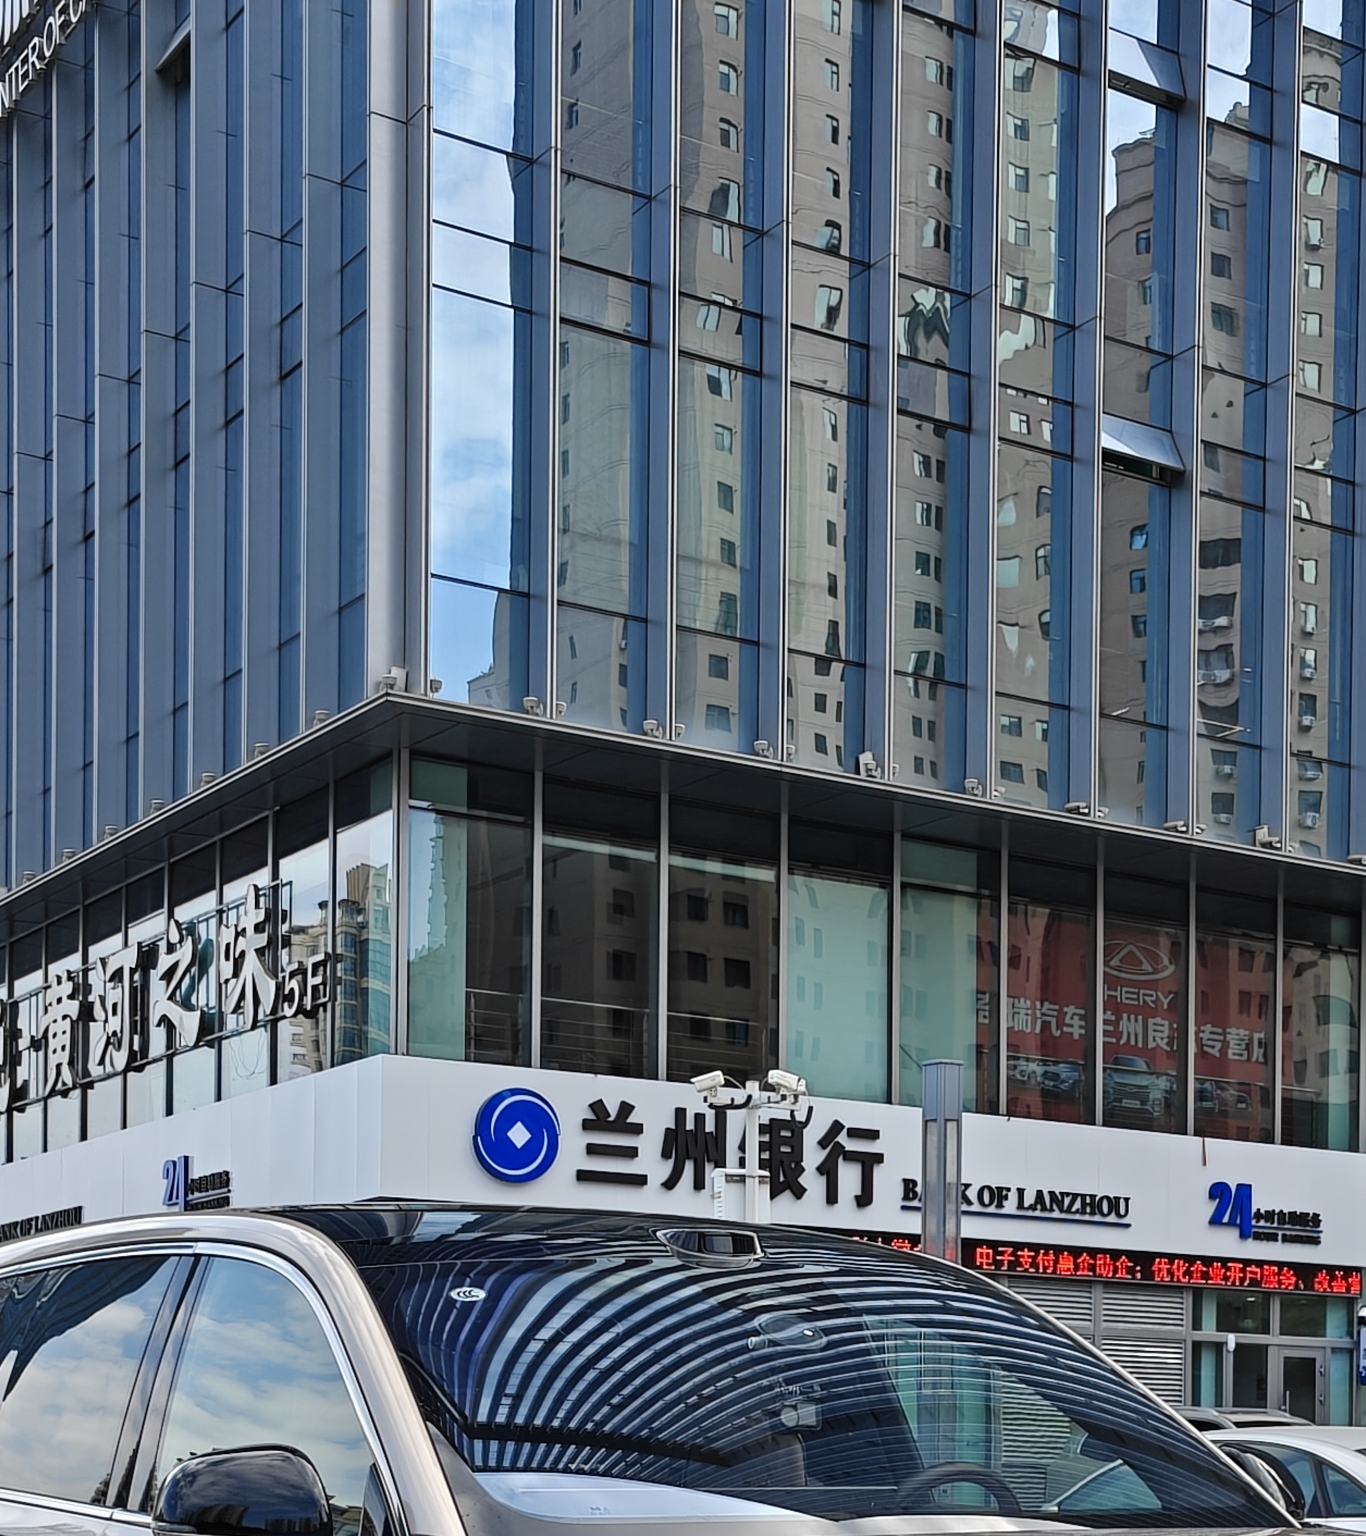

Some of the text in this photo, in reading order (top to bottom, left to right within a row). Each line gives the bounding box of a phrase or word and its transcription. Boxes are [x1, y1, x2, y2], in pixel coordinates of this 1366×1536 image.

[43, 2, 68, 59] OF
[1103, 984, 1175, 1010] HERY
[575, 1097, 885, 1208] 兰州银行
[161, 1155, 190, 1212] 24
[901, 1177, 1131, 1220] BK OF LANZHOU
[1207, 1181, 1253, 1240] 24
